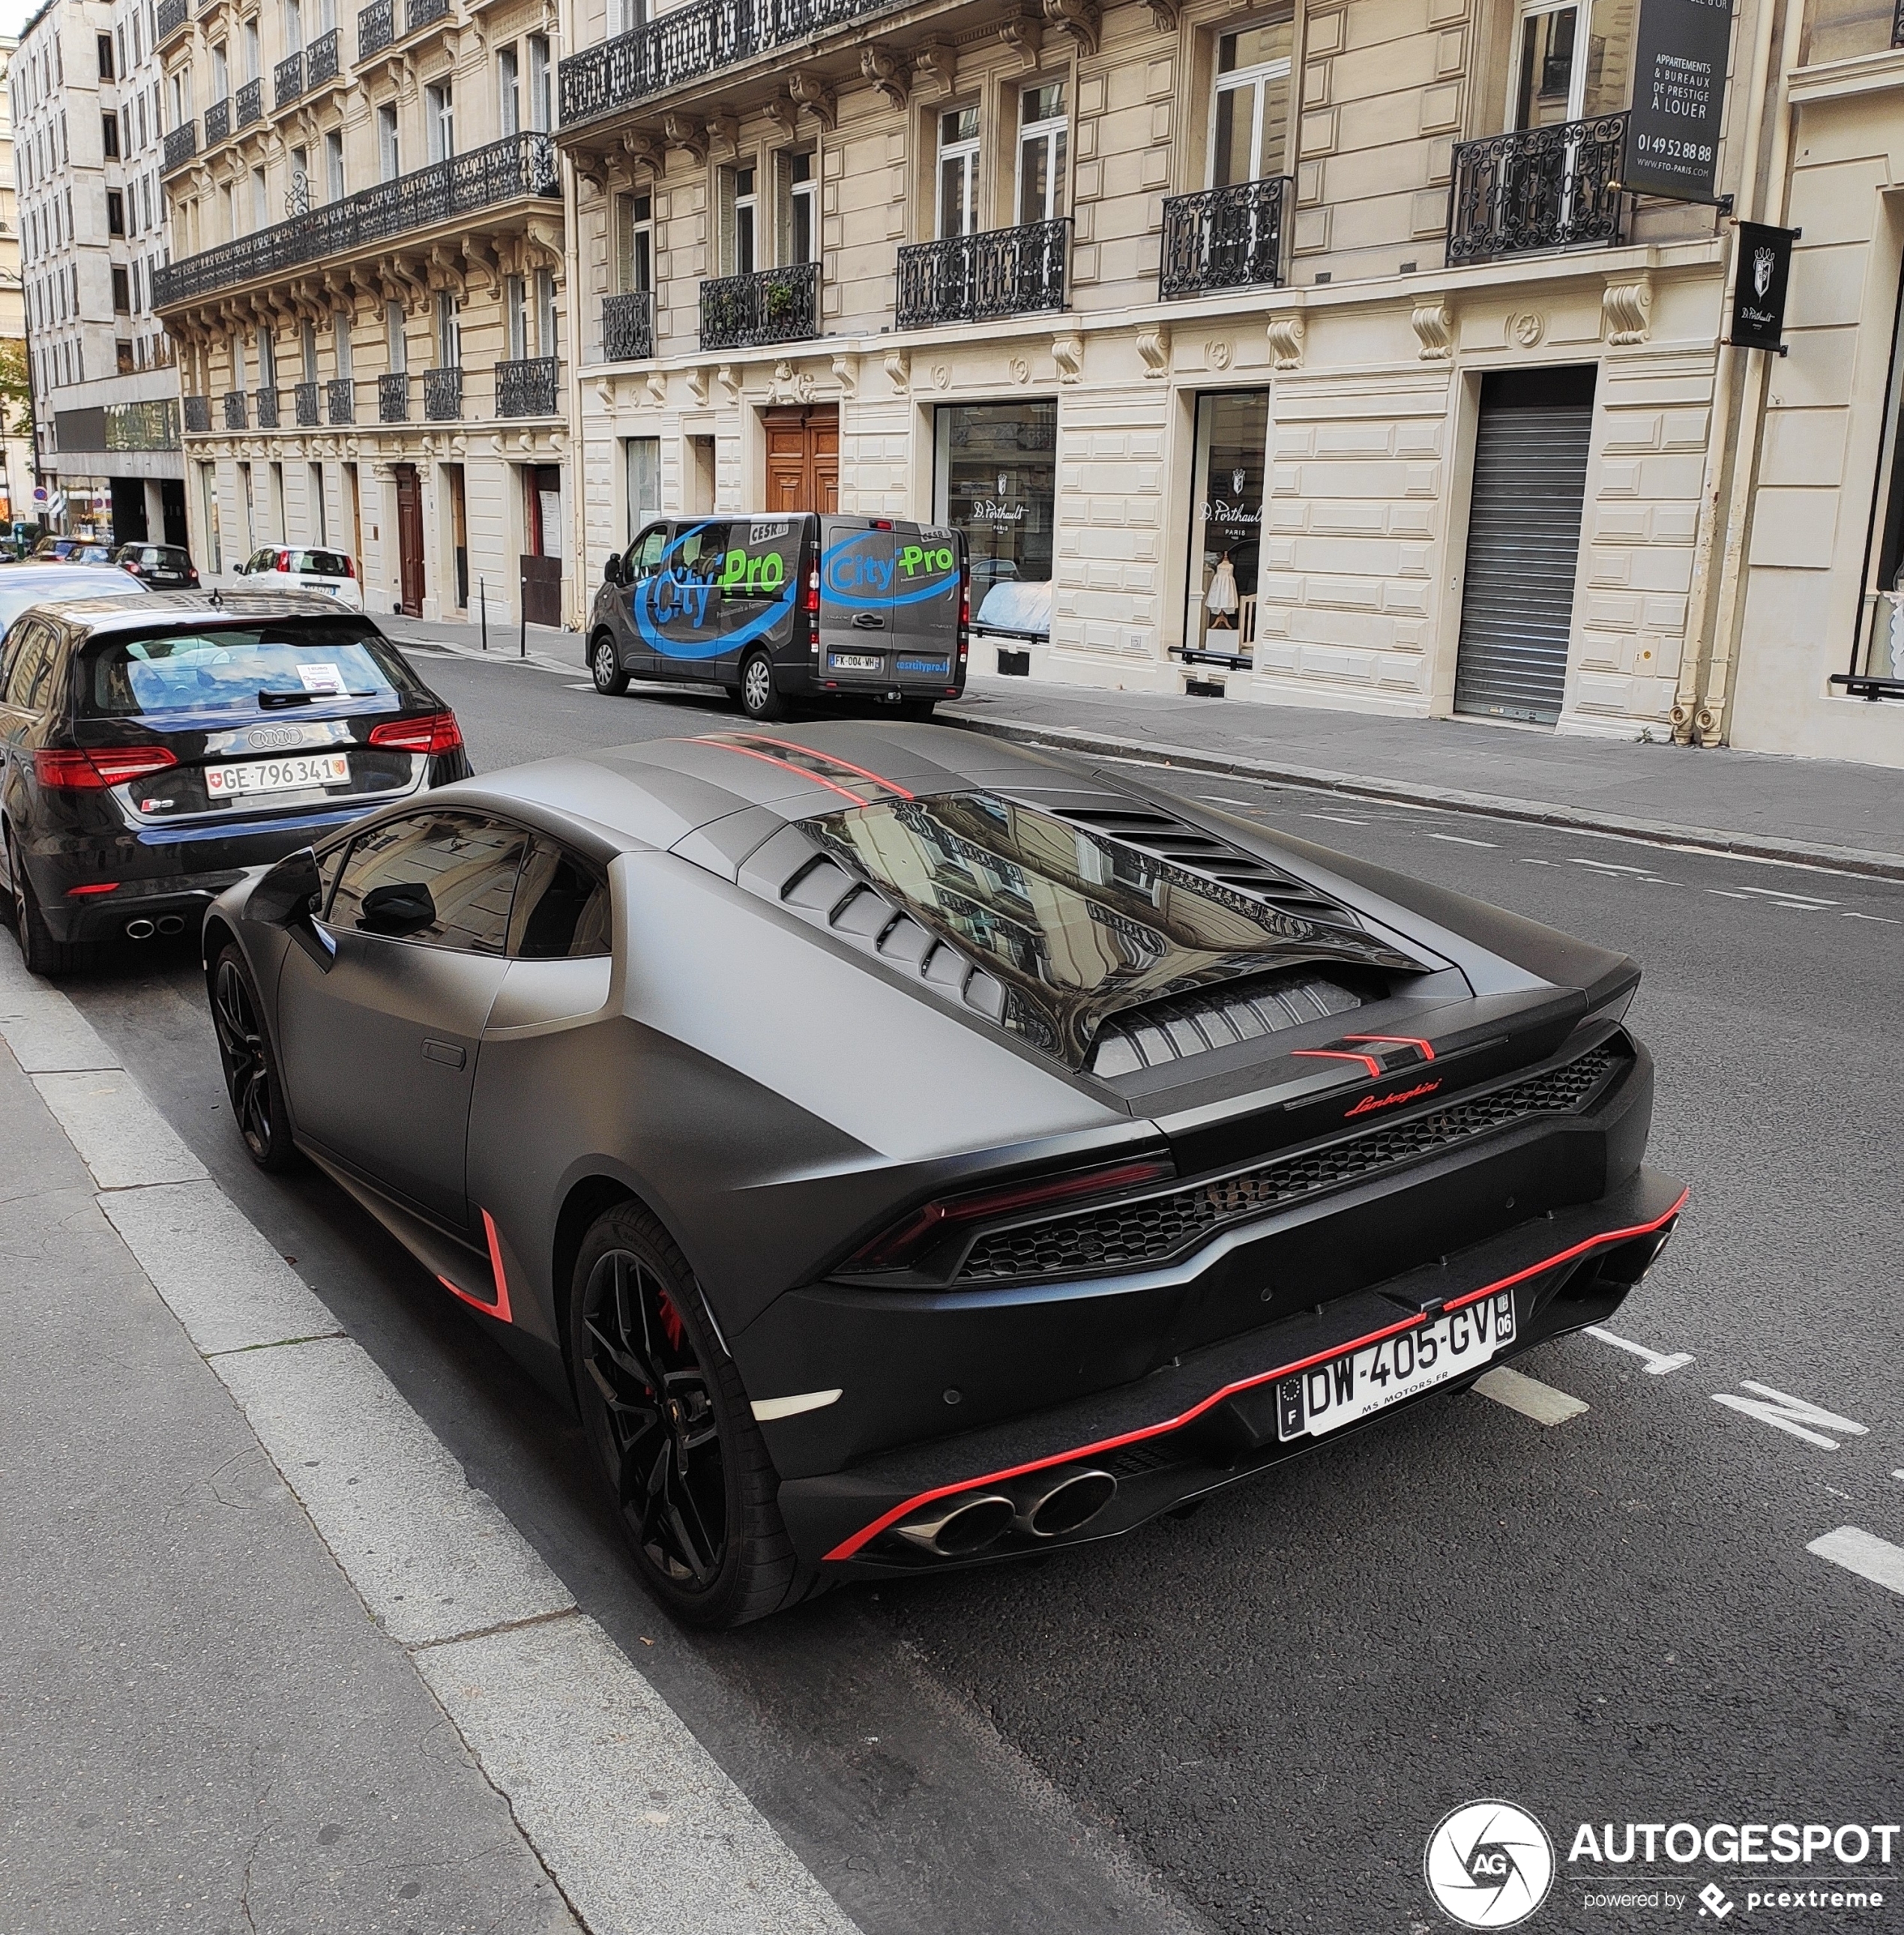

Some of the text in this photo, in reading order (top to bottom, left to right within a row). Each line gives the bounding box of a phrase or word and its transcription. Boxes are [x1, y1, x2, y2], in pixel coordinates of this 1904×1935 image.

[1708, 0, 1727, 10] dOR
[1656, 53, 1711, 74] APPARTEMENTS
[1654, 67, 1710, 88] & BUREAUX
[1653, 82, 1710, 102] DE PRESTIGE
[1651, 93, 1707, 119] À LOUER
[1636, 157, 1709, 178] WWW.FTO-PARIS.COM
[1214, 499, 1263, 523] Porthaul
[752, 524, 778, 542] CESR
[922, 530, 944, 541] CESR
[1344, 1077, 1443, 1117] Lamborghini
[1497, 1313, 1512, 1337] 06
[1361, 1370, 1449, 1415] MS MOTORS.FR
[1288, 1409, 1298, 1425] F
